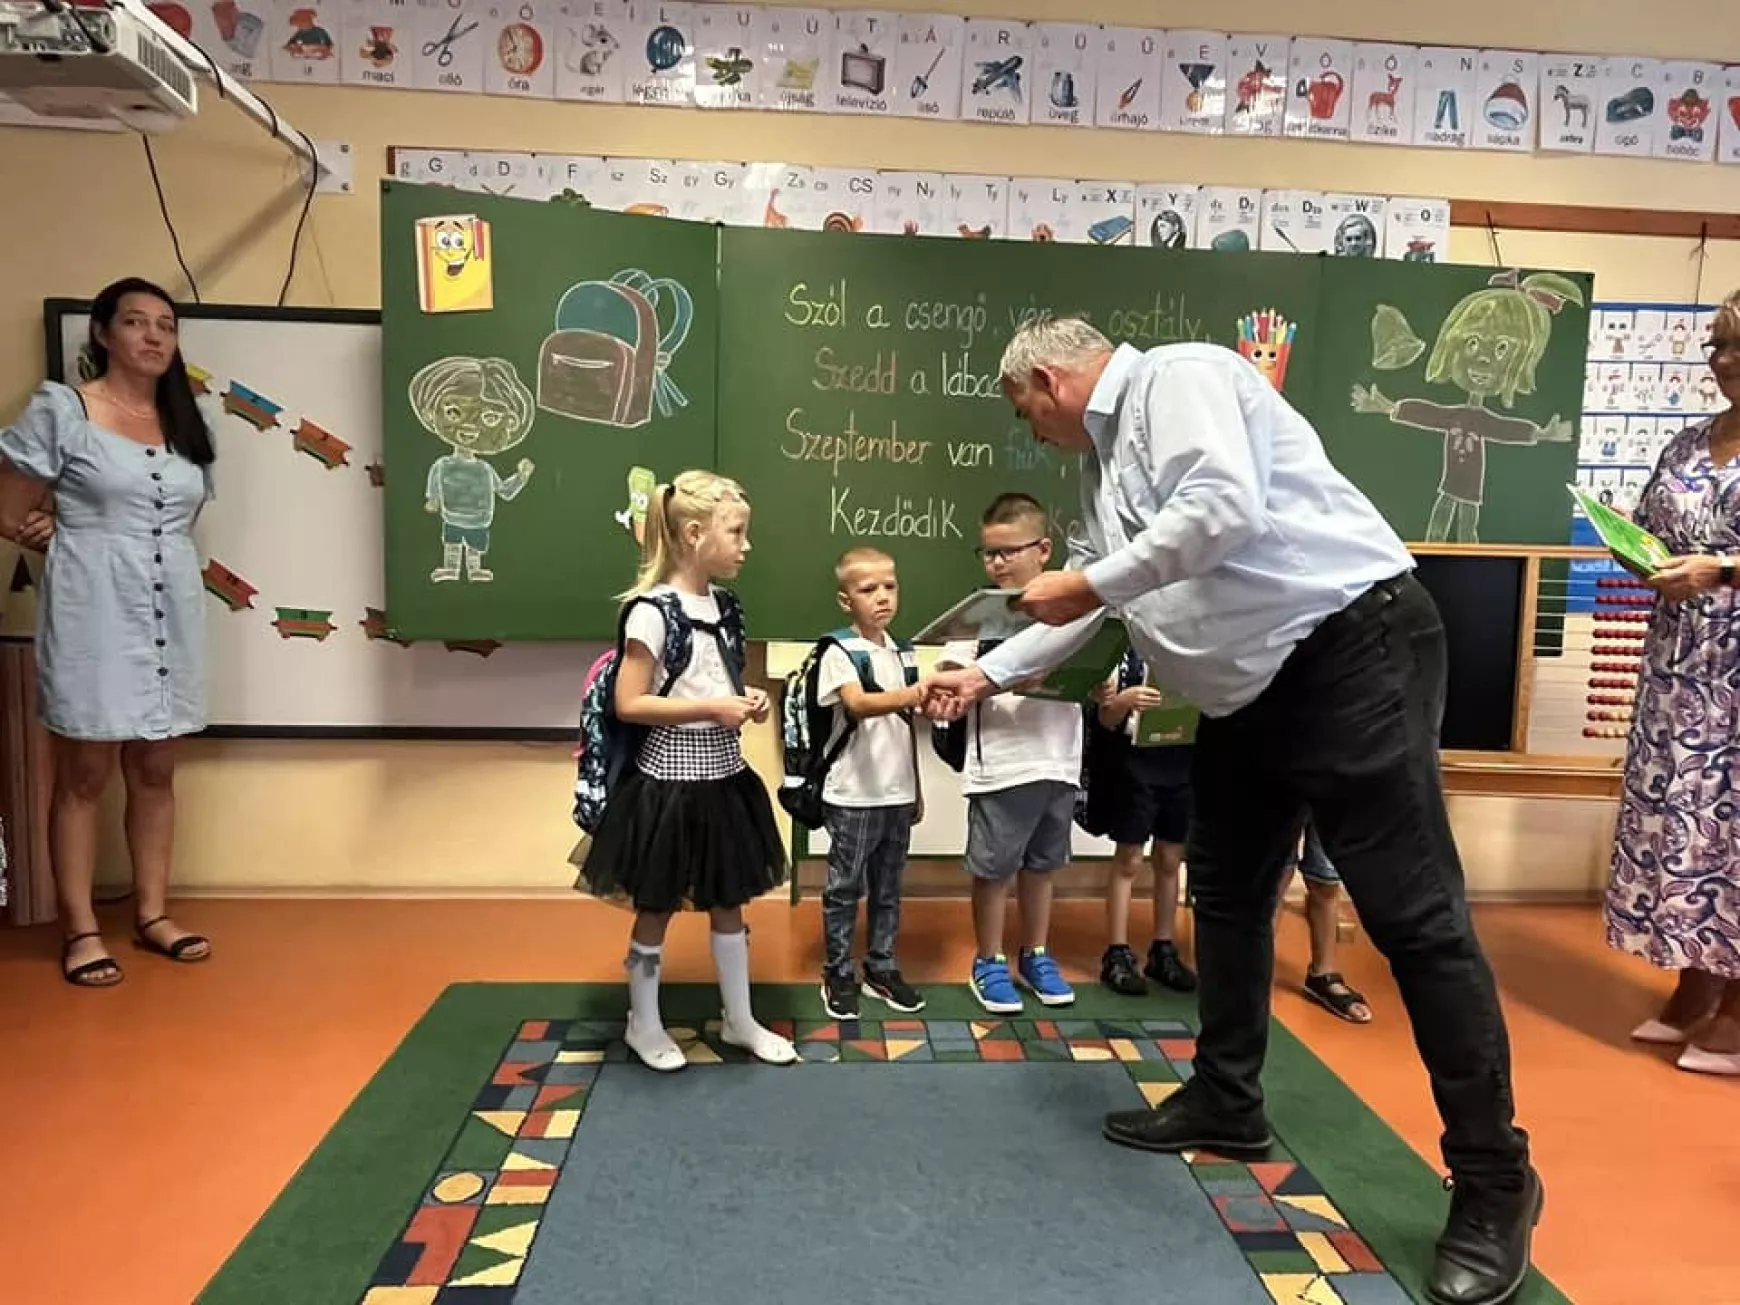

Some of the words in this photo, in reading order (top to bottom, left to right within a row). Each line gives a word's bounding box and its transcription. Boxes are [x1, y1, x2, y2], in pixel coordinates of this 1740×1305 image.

[658, 7, 671, 23] L
[737, 10, 750, 27] U
[867, 17, 877, 33] T
[997, 30, 1010, 44] R
[1256, 43, 1268, 57] V
[1460, 57, 1473, 71] N
[1512, 59, 1524, 73] S
[1573, 63, 1584, 77] Z
[1631, 63, 1643, 78] C
[362, 71, 395, 83] maci
[508, 77, 530, 90] óra
[1693, 70, 1704, 84] B
[836, 94, 887, 111] televízió
[428, 157, 443, 173] G
[497, 160, 511, 176] D
[567, 164, 578, 178] F
[650, 168, 668, 184] Sz
[713, 171, 735, 189] Gy
[849, 177, 873, 193] CS
[916, 182, 935, 199] Ny
[1106, 189, 1117, 203] X
[1168, 193, 1178, 206] Y
[1355, 200, 1369, 213] W
[784, 278, 846, 328] Szól
[866, 307, 891, 329] a
[811, 346, 897, 394] Szedd
[910, 369, 929, 394] a
[780, 407, 932, 478] Szeptember
[947, 439, 993, 467] van
